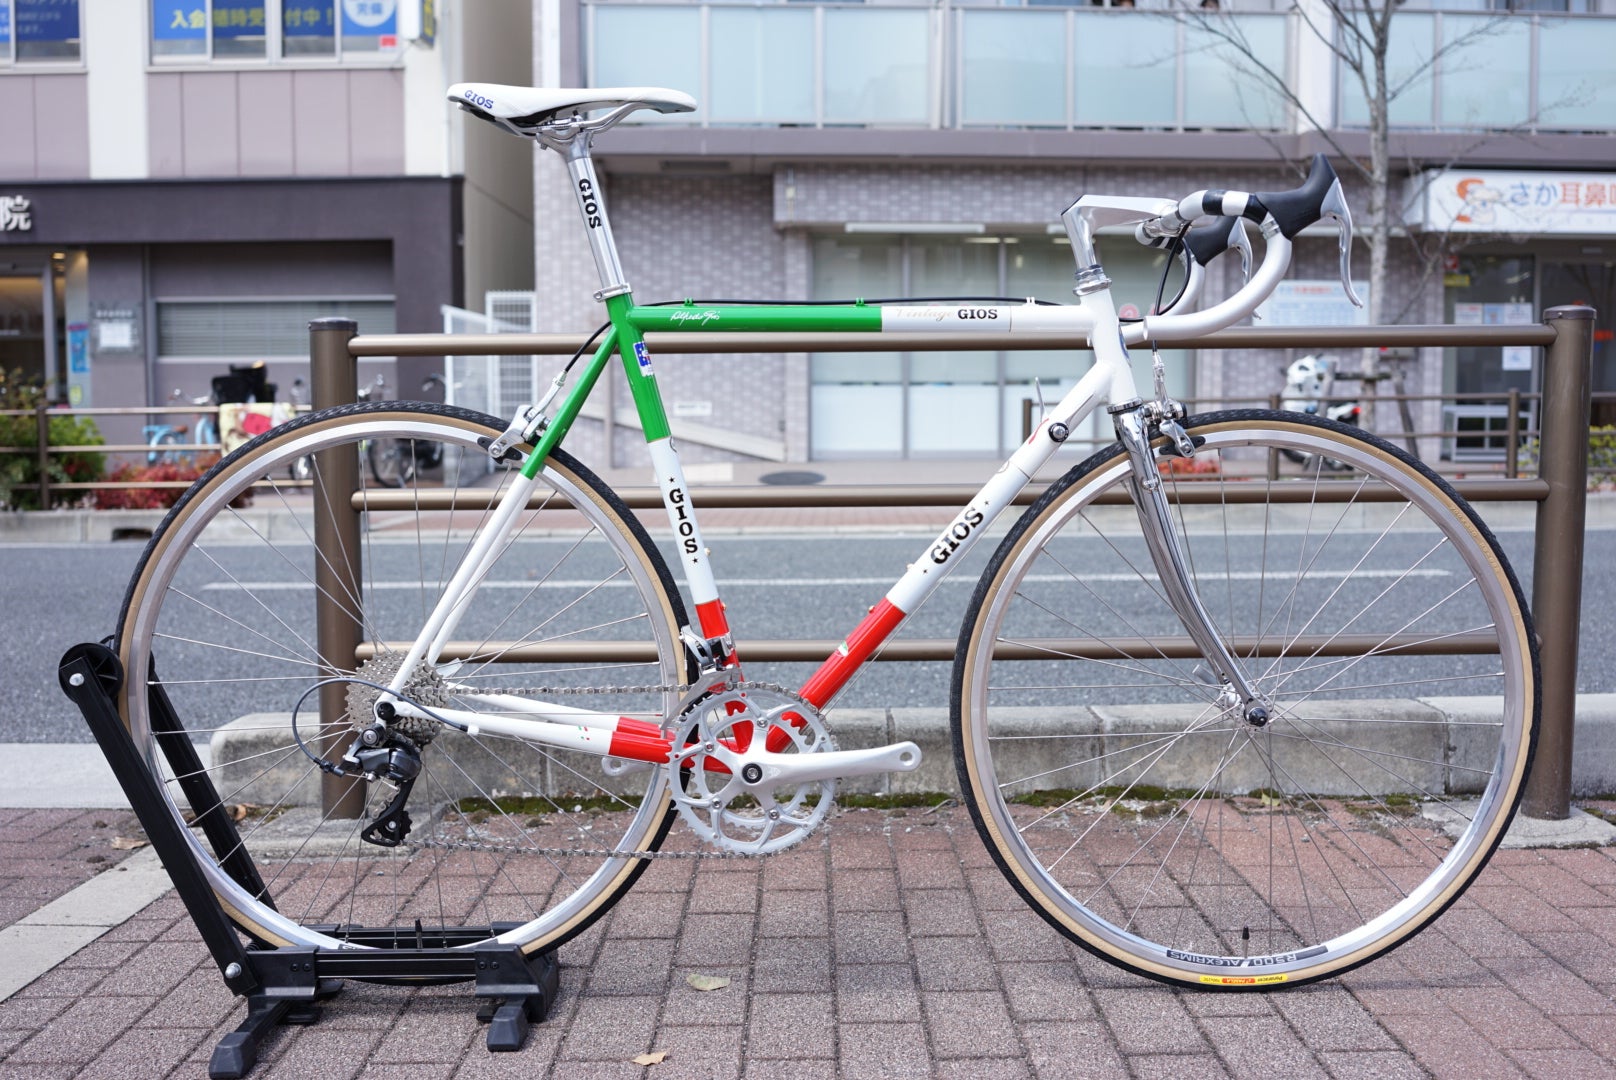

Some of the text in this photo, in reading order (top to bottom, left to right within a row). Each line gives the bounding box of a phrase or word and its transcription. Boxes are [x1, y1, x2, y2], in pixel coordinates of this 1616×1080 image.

[464, 90, 494, 109] GIOS
[578, 178, 601, 229] GIOS
[957, 308, 998, 320] GIOS
[669, 488, 698, 554] GIOS
[930, 506, 984, 564] GIOS
[1170, 951, 1297, 967] R500 ALEXRIMS
